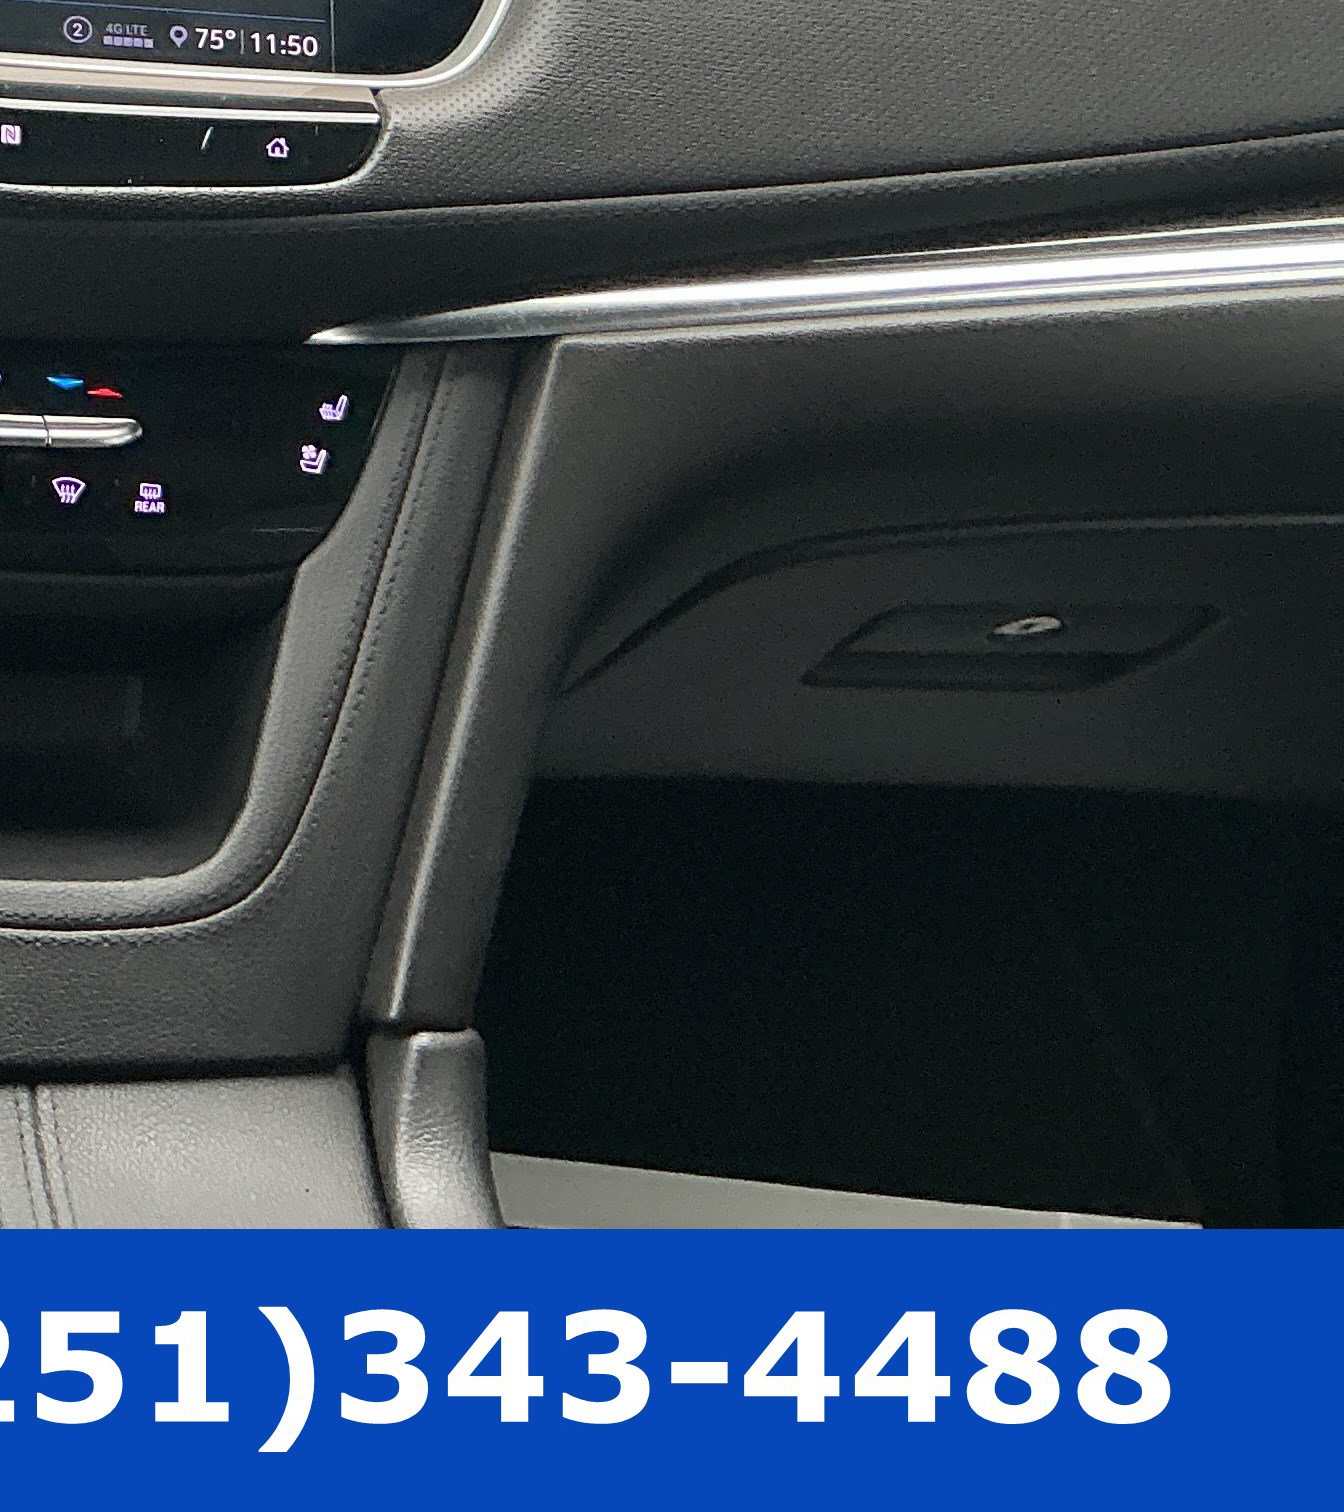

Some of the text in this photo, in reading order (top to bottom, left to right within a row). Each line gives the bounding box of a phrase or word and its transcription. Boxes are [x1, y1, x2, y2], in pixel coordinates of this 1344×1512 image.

[105, 22, 149, 37] 4G LTE
[250, 32, 319, 57] 11:50
[134, 500, 166, 515] REAR
